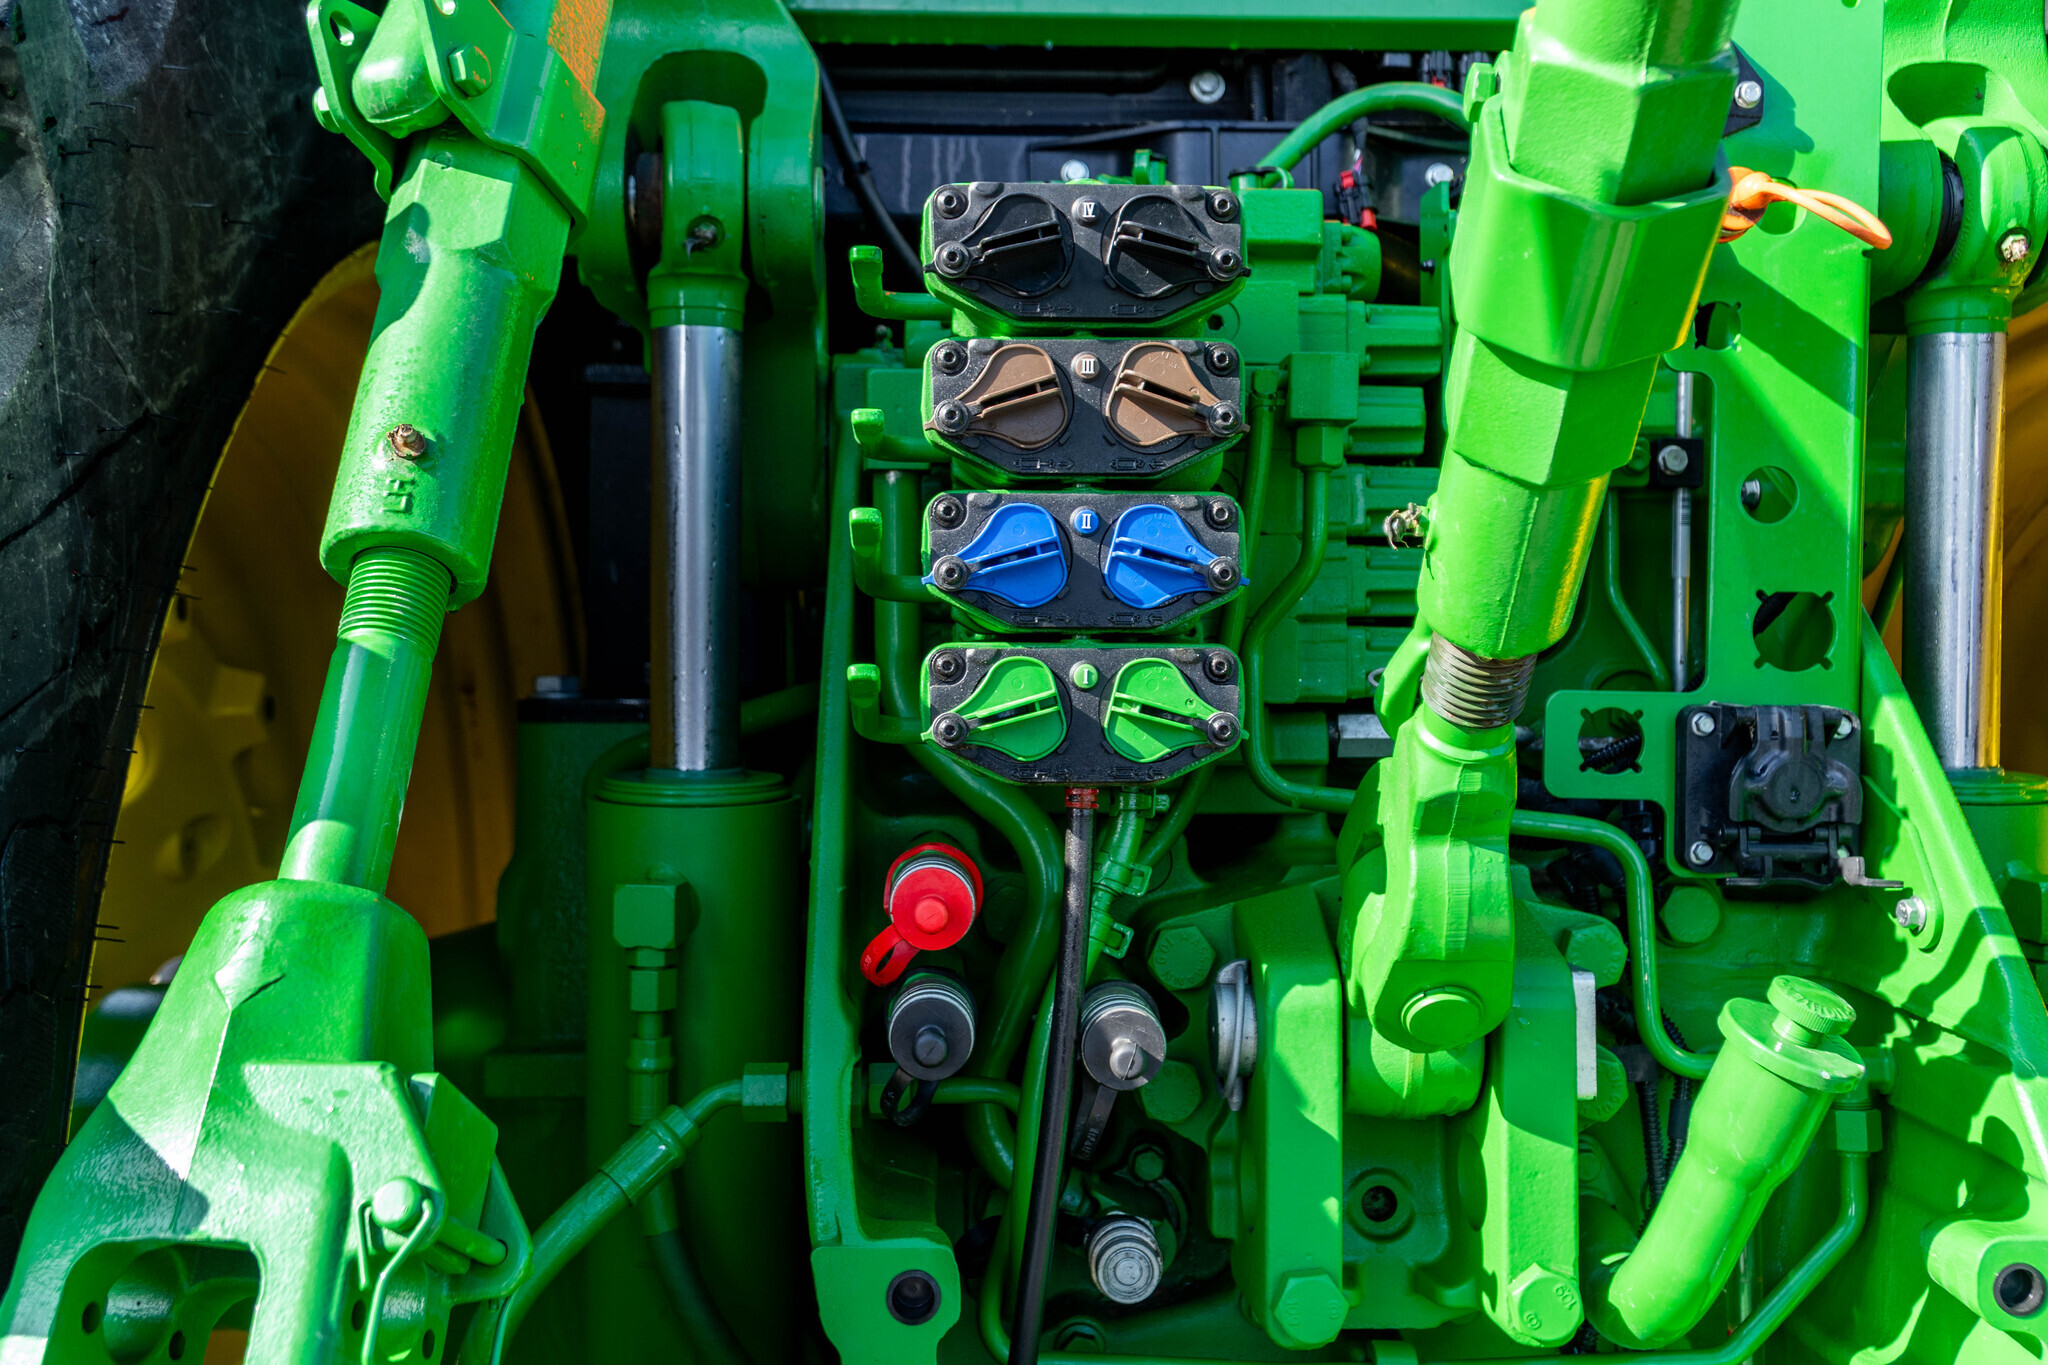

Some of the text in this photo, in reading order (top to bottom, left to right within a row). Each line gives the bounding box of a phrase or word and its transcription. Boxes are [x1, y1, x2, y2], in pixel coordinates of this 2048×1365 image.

[1082, 202, 1096, 218] IV
[1081, 358, 1096, 374] III
[1081, 513, 1092, 529] II
[1082, 668, 1089, 684] I
